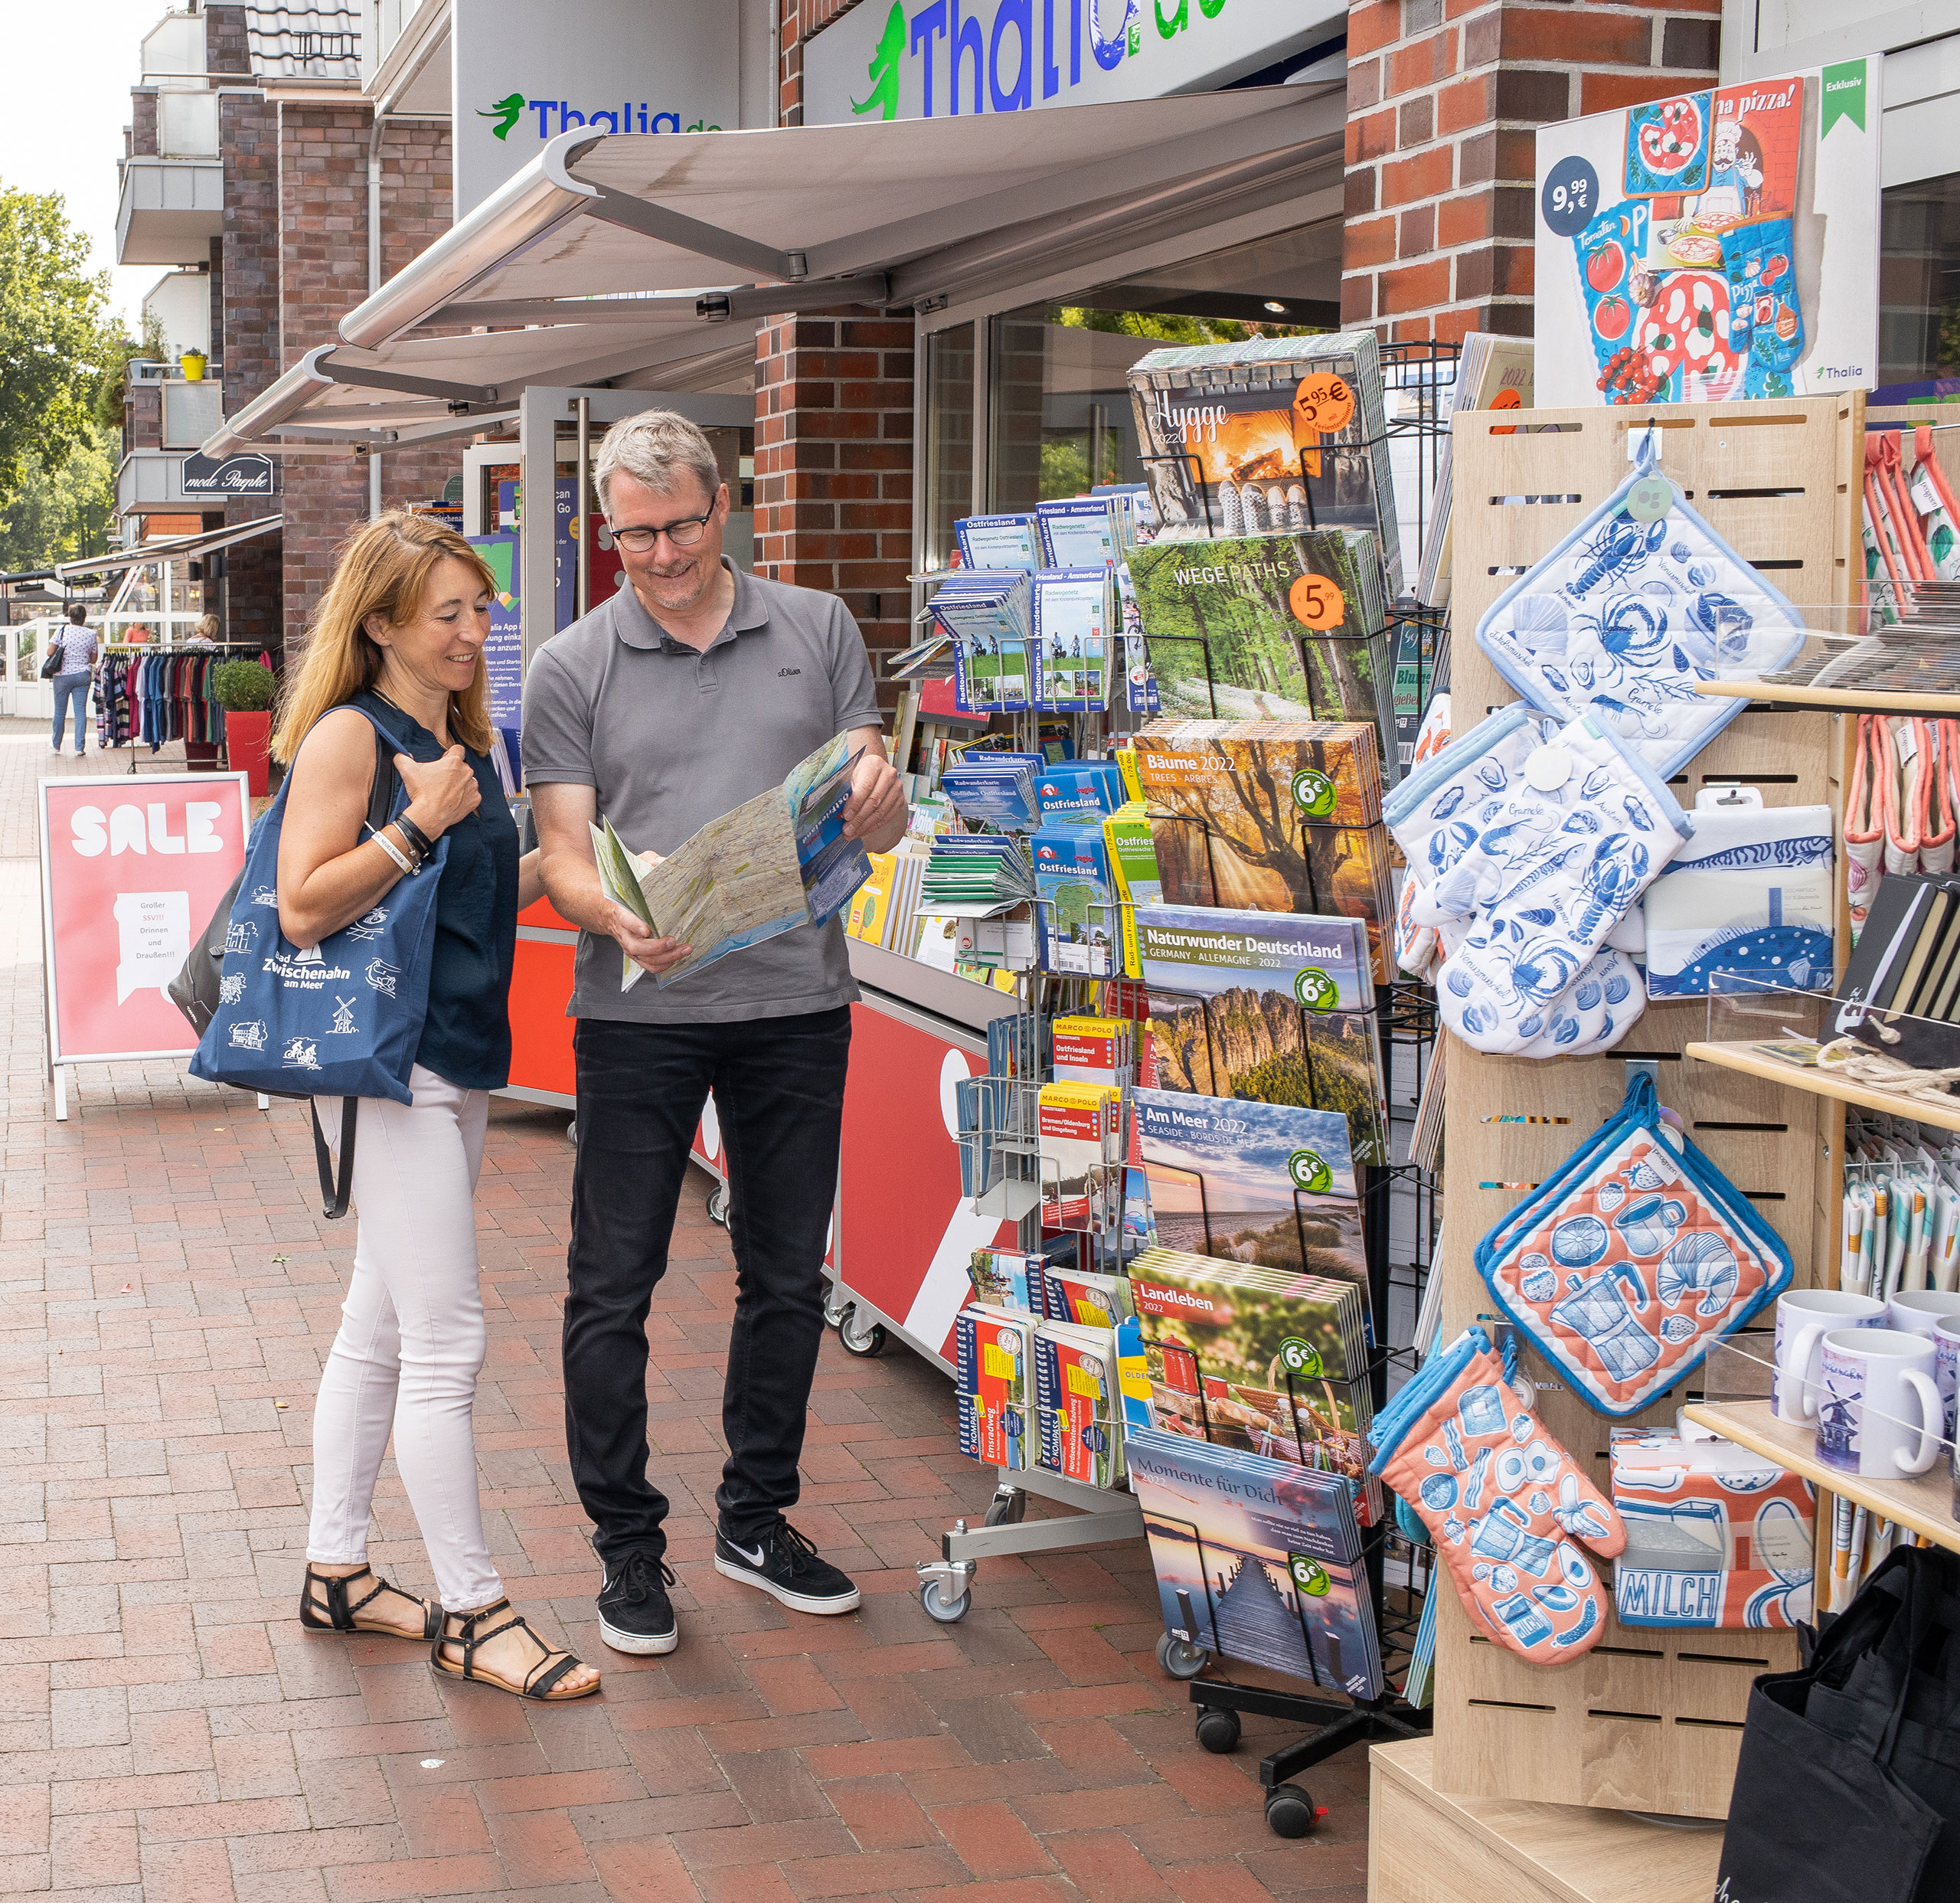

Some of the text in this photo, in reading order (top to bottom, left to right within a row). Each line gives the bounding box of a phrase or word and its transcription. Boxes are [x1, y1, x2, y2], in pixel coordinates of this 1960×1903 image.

[1825, 77, 1863, 93] Exklusiv
[1737, 83, 1795, 123] pizza!
[1577, 219, 1617, 250] Tomaten
[1500, 367, 1527, 387] 2022
[1826, 365, 1864, 381] Thalia
[1149, 391, 1230, 444] Hygge
[1314, 401, 1352, 431] Ferienterminen
[1328, 414, 1338, 422] mit
[1152, 433, 1178, 445] 2022
[557, 502, 571, 514] Go
[1070, 504, 1105, 514] Ammerland
[966, 518, 1017, 528] Ostfriesland
[1067, 571, 1103, 580] Ammerland
[1172, 560, 1291, 585] WEGE PATHS
[940, 603, 987, 611] Ostfriesland
[503, 623, 518, 632] App
[1034, 641, 1041, 650] u.
[1627, 688, 1664, 716] Garnele
[1147, 754, 1237, 772] Bäume 2022
[1150, 772, 1219, 785] TREES ARBRES
[1043, 796, 1101, 810] OstFriesland
[70, 801, 224, 858] SALE
[1039, 862, 1098, 876] OstFriesland
[140, 901, 166, 910] Großer
[142, 913, 165, 922] SSV!!!
[139, 926, 169, 934] Drinnen
[1127, 930, 1135, 945] und
[1148, 929, 1343, 960] Naturwunder Deutschland
[136, 950, 175, 960] Draußen!!!
[275, 950, 291, 963] Bad
[1149, 948, 1282, 969] GERMANY ALLEMAGNE 2022
[262, 958, 351, 980] Zwischenahn
[1458, 946, 1513, 1000] Venusmuschel
[283, 979, 325, 990] am Meer
[1056, 1023, 1083, 1032] MARCO
[1056, 1044, 1096, 1054] Ostfriesland
[1069, 1054, 1089, 1063] Inseln
[1041, 1094, 1069, 1104] MARCO
[1041, 1117, 1091, 1130] Bremen/Oldenburg
[1146, 1107, 1248, 1135] Am Meer 2022
[1051, 1126, 1078, 1136] Umgebung
[1148, 1124, 1256, 1148] SEASIDE BORDS DE MER
[1651, 1148, 1678, 1175] peagreen
[1140, 1283, 1214, 1311] Landleben
[1143, 1301, 1165, 1313] 2022
[985, 1408, 995, 1459] Emsradweg
[1069, 1398, 1077, 1473] Nordseeküsten-Radweg
[1138, 1457, 1284, 1506] Momente für Dich
[1141, 1473, 1168, 1488] 2022
[1619, 1572, 1717, 1623] MILCH
[1514, 1617, 1540, 1642] MILCH
